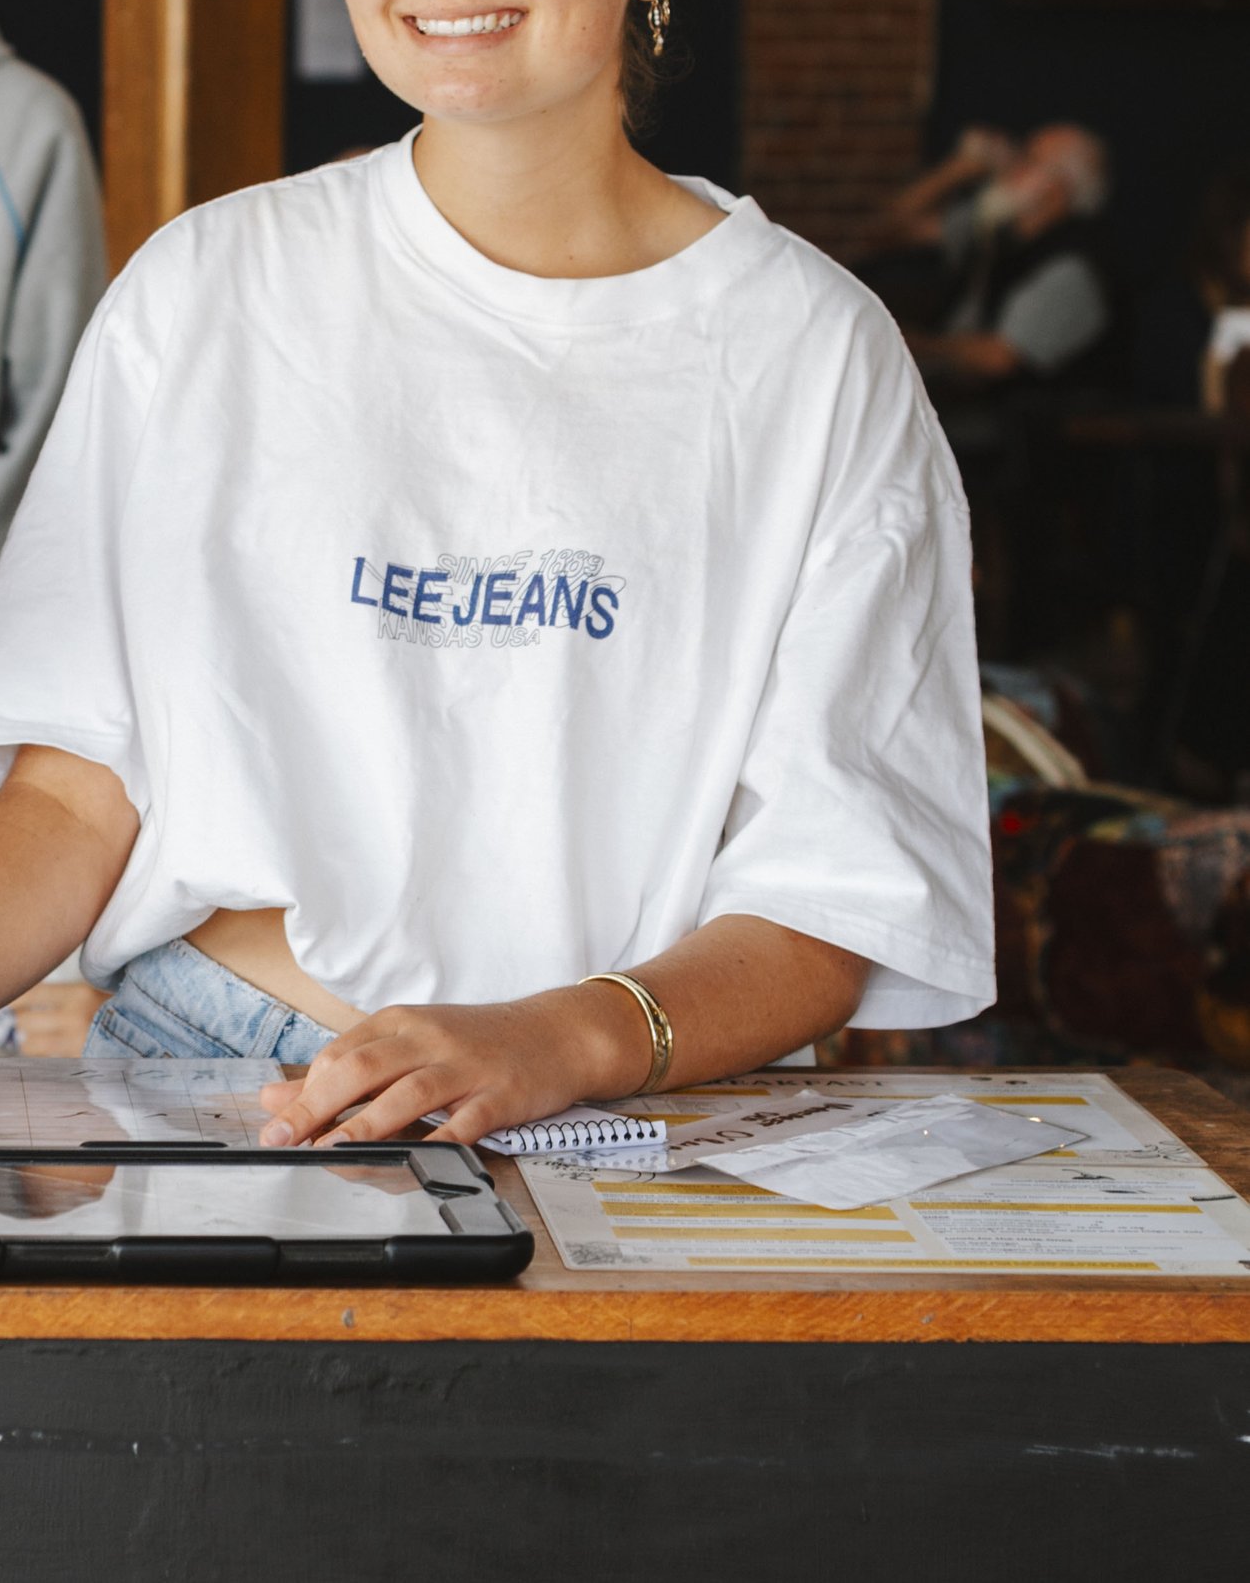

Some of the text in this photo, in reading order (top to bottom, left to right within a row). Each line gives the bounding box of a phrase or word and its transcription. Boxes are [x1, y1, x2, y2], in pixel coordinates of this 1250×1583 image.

[539, 547, 606, 581] 1889
[350, 556, 619, 640] LEE JEANS
[377, 600, 540, 649] KANSAS USA
